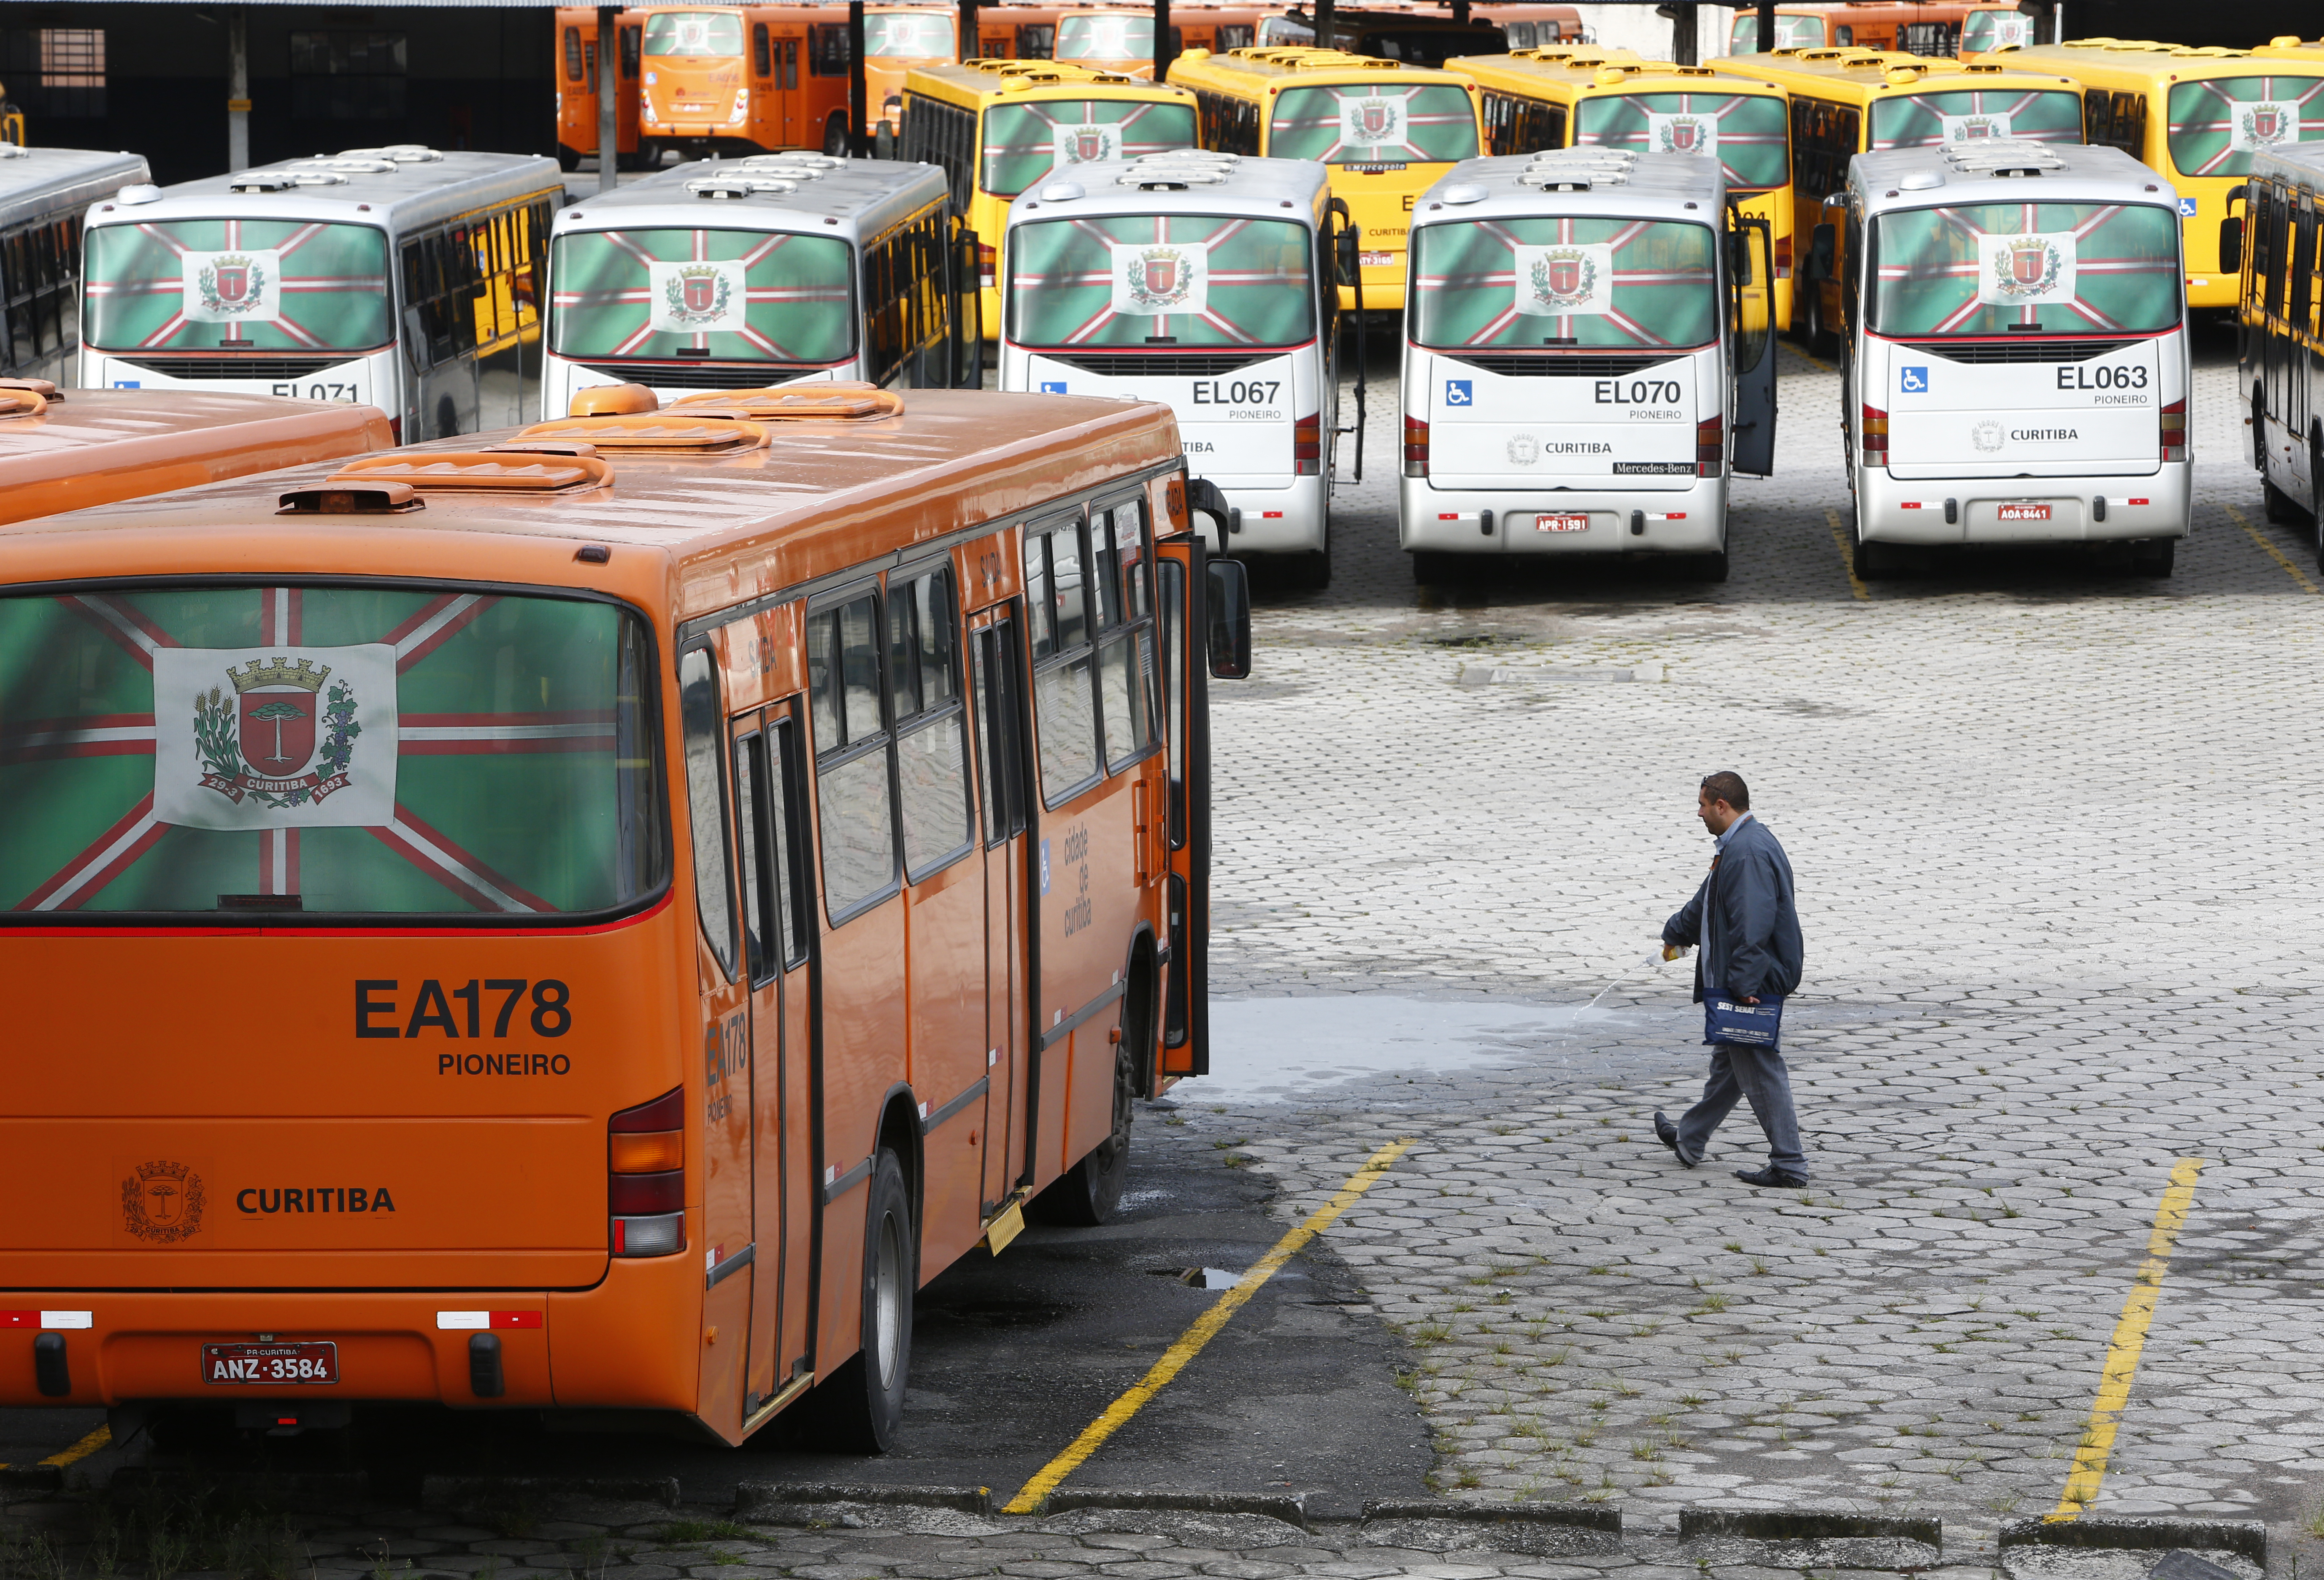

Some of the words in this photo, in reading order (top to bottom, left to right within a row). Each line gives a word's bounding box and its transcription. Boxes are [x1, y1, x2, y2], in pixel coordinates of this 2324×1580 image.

[2056, 365, 2148, 390] EL063
[1192, 381, 1281, 404] EL067
[1594, 381, 1681, 404] EL070
[2094, 395, 2148, 405] PIONEIRO
[1229, 410, 1281, 419] PIONEIRO
[1630, 410, 1682, 419] PIONEIRO
[2010, 428, 2079, 441] CURITIBA
[1545, 442, 1612, 455] CURITIBA
[1616, 463, 1693, 474] Mercedes-Benz
[1156, 487, 1184, 522] ENTRADA
[980, 546, 1002, 588] SAÍDA
[748, 629, 777, 679] SAÍDA
[208, 778, 238, 797] 29-3
[246, 778, 308, 791] CURITIBA
[314, 777, 343, 798] 1693
[1065, 822, 1088, 866] cidade
[1079, 858, 1089, 894] de
[1064, 893, 1092, 938] curitiba
[355, 979, 572, 1039] EA178
[1716, 1001, 1734, 1012] SEST
[1735, 1005, 1756, 1014] SENAT
[707, 1011, 746, 1088] EA178
[438, 1053, 571, 1076] PIONEIRO
[707, 1093, 732, 1125] PIONEIRO
[236, 1188, 396, 1214] CURITIBA
[181, 1226, 196, 1238] 1693
